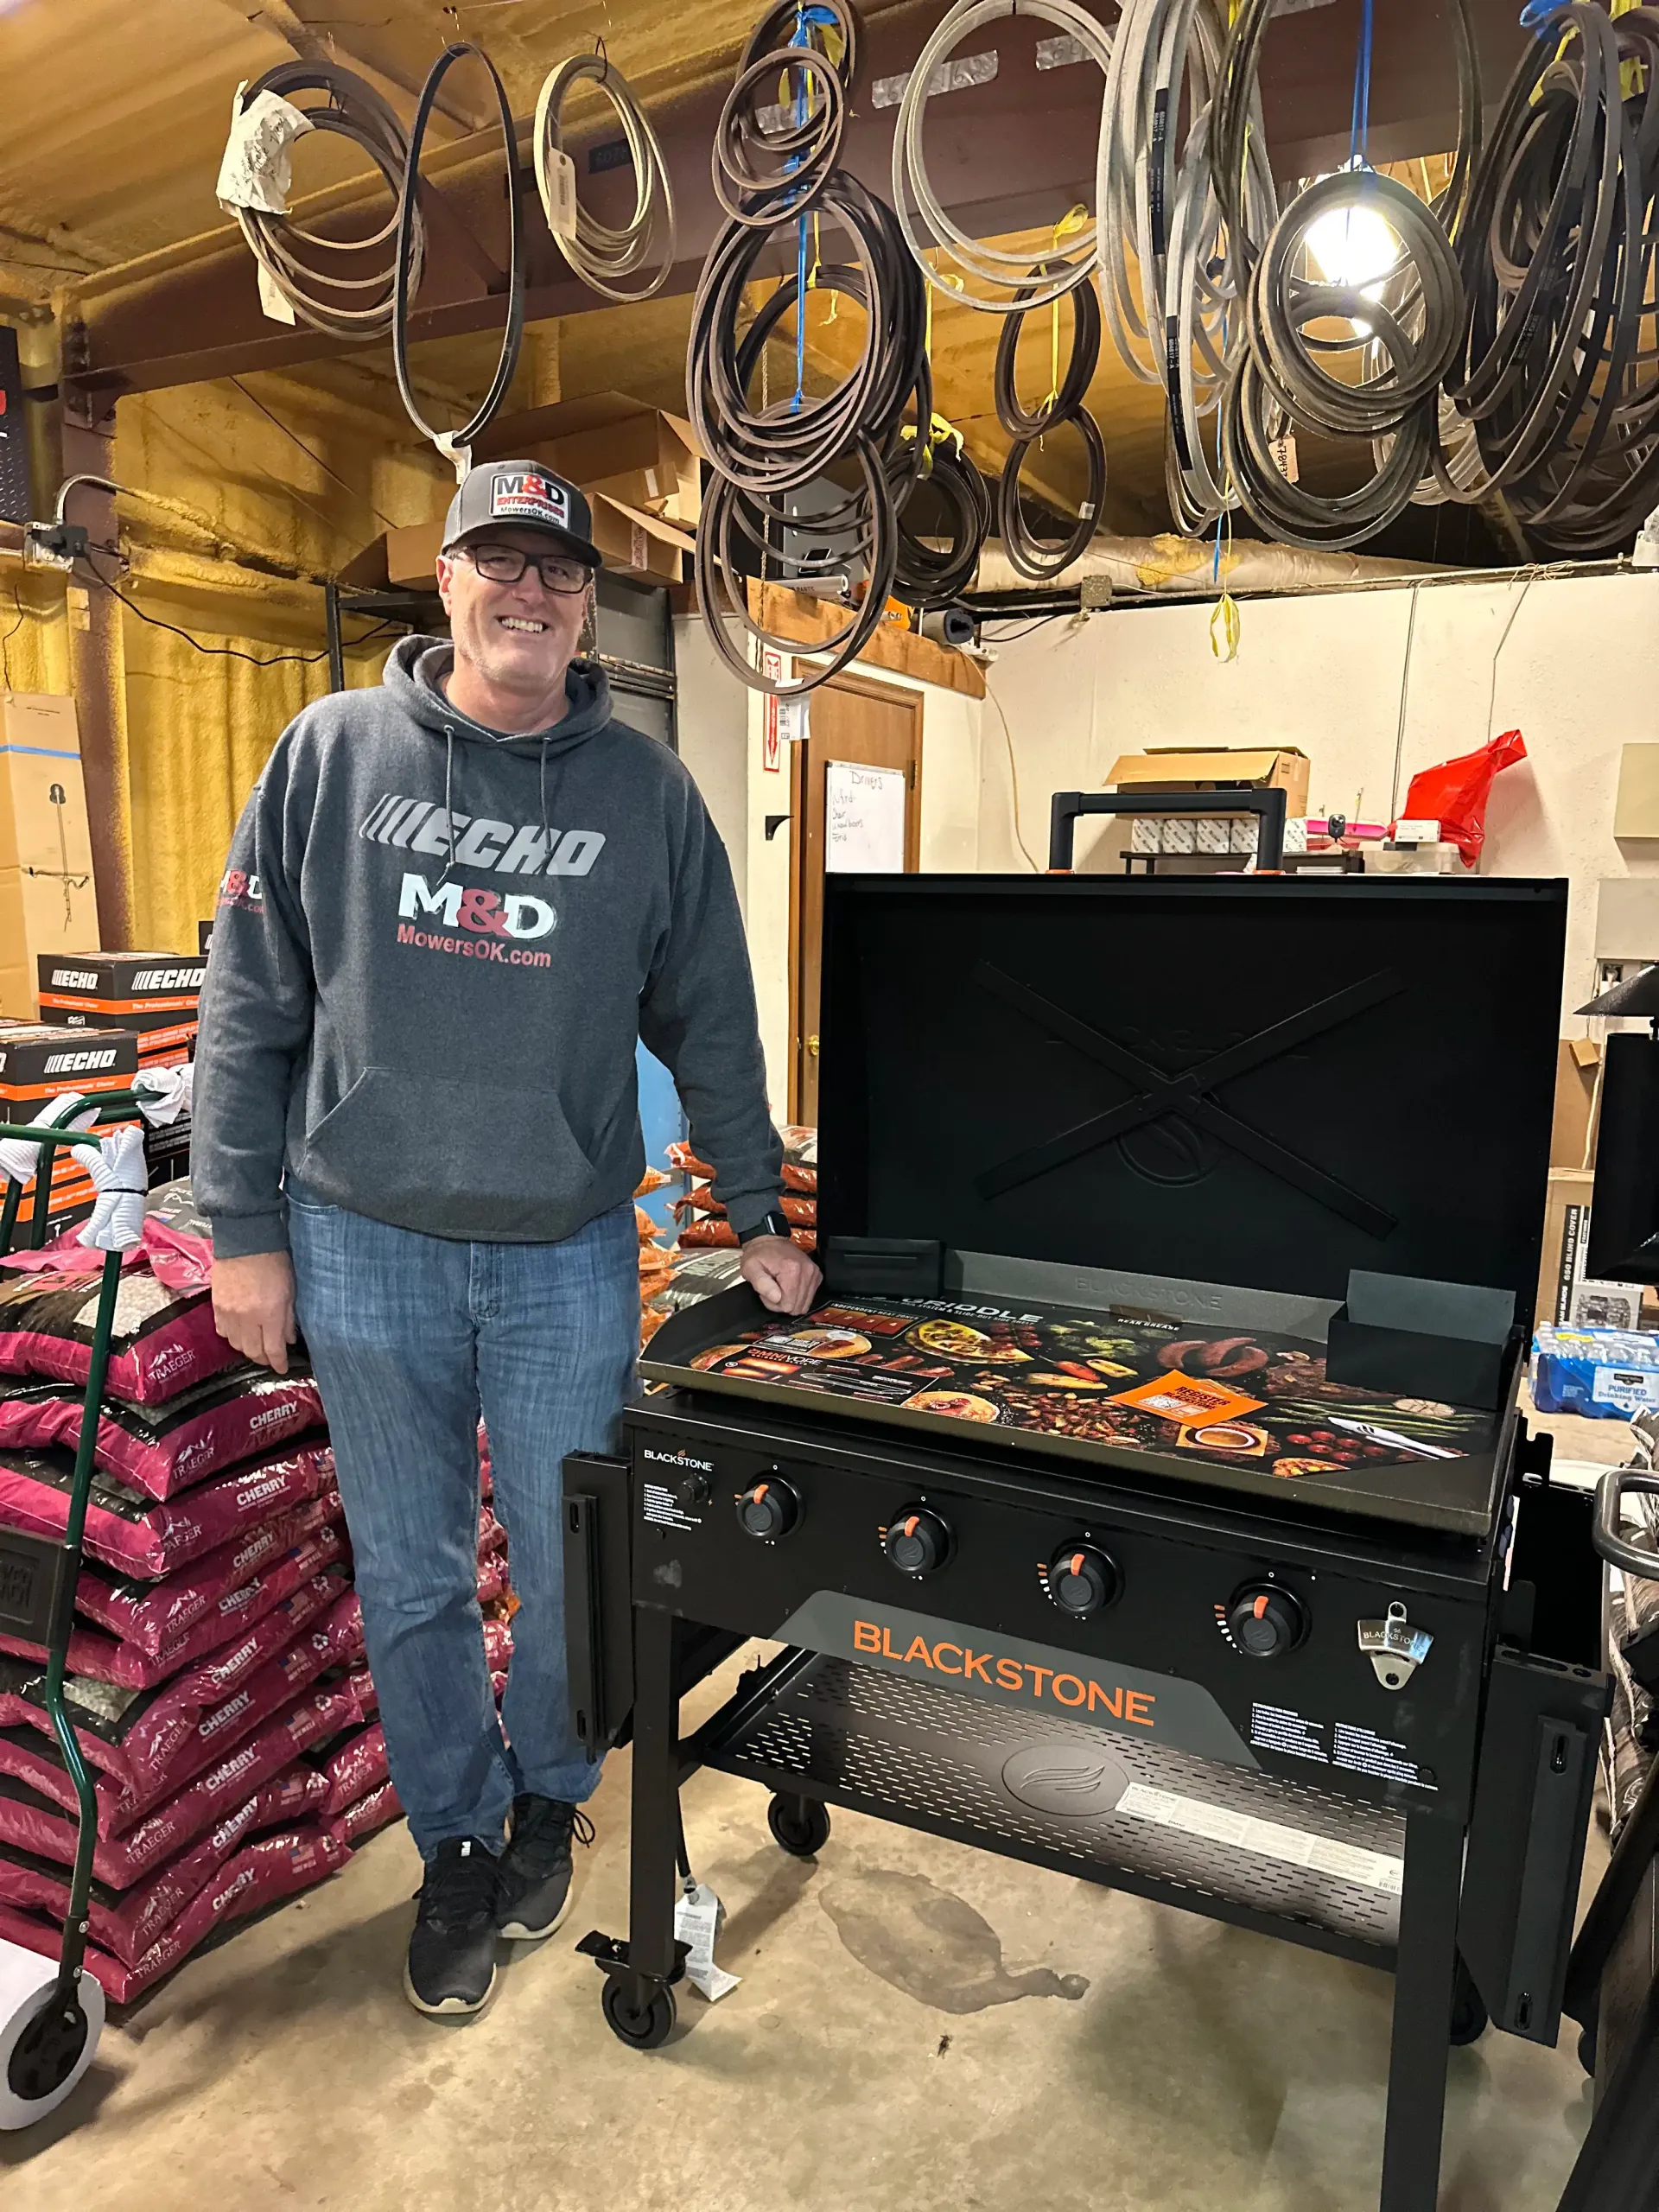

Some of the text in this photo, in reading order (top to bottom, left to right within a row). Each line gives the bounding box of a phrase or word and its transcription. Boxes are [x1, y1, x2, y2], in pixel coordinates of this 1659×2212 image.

[1276, 446, 1288, 477] 7843
[497, 474, 564, 505] M&D
[500, 505, 560, 524] MowersOK.com
[408, 805, 607, 876] ECHO
[397, 872, 558, 940] M&D
[397, 923, 552, 968] MowersOK.com
[60, 970, 99, 990] ECHO
[148, 968, 206, 990] ECHO
[60, 1049, 117, 1073] ECHO
[1568, 1208, 1579, 1236] COVER
[1565, 1237, 1575, 1265] BLIND
[830, 1302, 878, 1313] INDEPENDENT
[1075, 1277, 1224, 1311] BLACKSTONE
[148, 1349, 195, 1382] TRAEGER
[1173, 1385, 1232, 1407] REGISTER
[1598, 1391, 1632, 1402] Drinking
[1608, 1384, 1648, 1396] PURIFIED
[249, 1401, 298, 1430] CHERRY
[174, 1446, 215, 1480] TRAEGER
[644, 1449, 713, 1472] BLACKSTONE
[236, 1475, 286, 1507] CHERRY
[232, 1532, 275, 1568] CHERRY
[166, 1595, 206, 1634] TRAEGER
[211, 1637, 258, 1686] CHERRY
[854, 1620, 1156, 1727] BLACKSTONE
[198, 1691, 251, 1737] CHERRY
[149, 1717, 188, 1772] TRAEGER
[205, 1746, 257, 1791] CHERRY
[125, 1821, 176, 1864] TRAEGER
